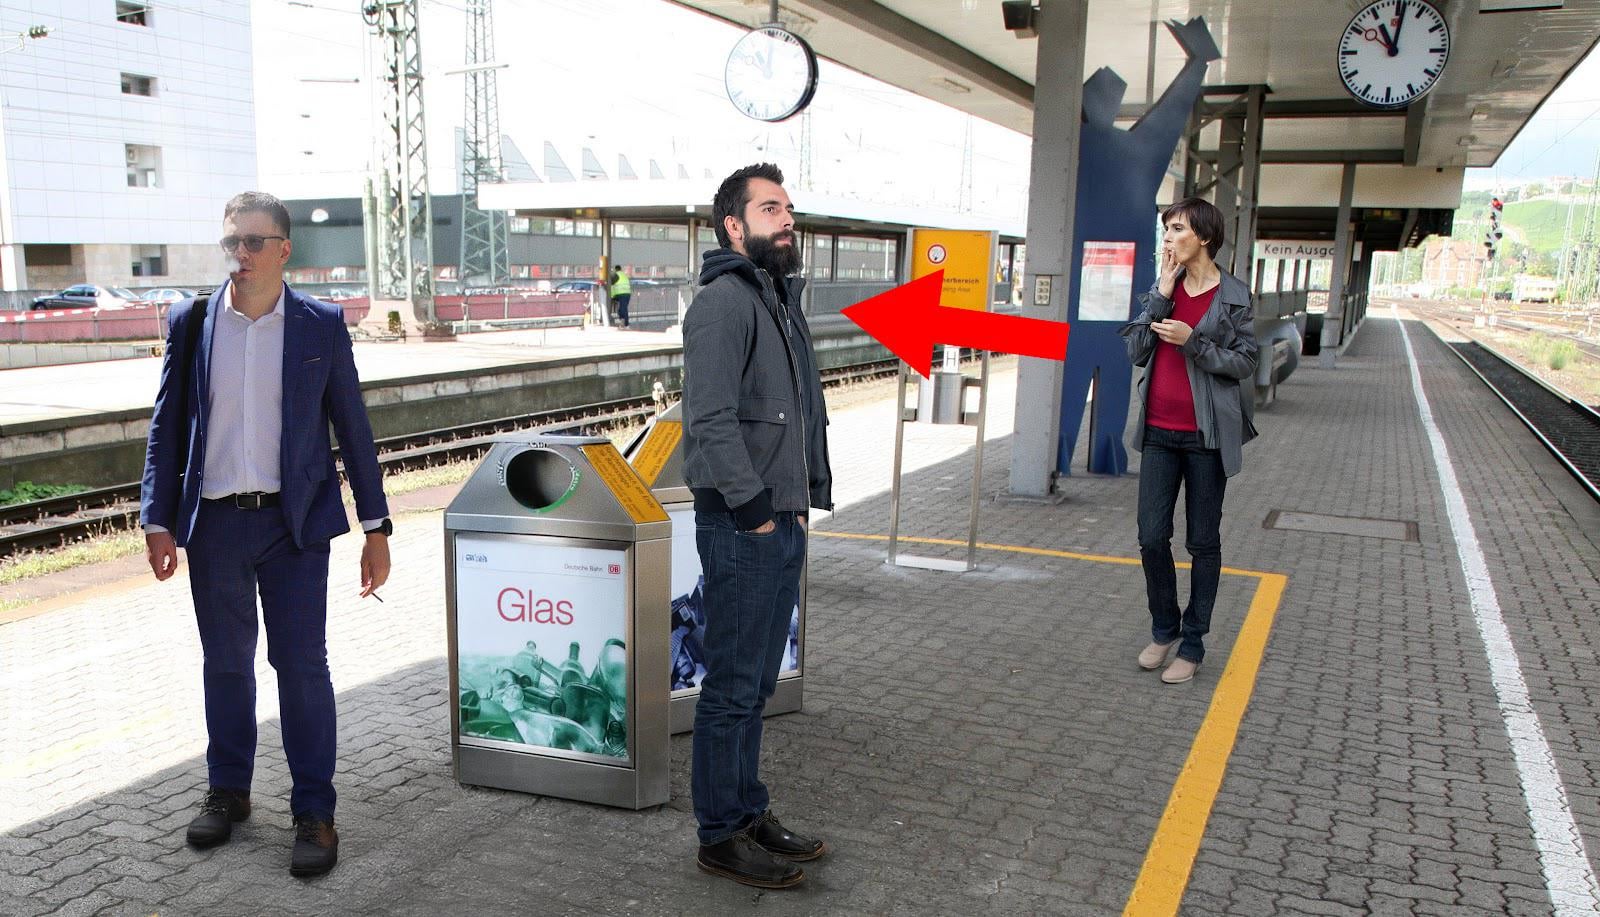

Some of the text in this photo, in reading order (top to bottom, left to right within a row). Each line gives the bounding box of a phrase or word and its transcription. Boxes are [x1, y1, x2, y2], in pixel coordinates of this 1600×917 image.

[1264, 243, 1335, 257] Kein Ausga
[944, 277, 980, 285] erbereich
[946, 351, 956, 367] H
[564, 563, 588, 571] Deutsche
[609, 564, 620, 574] DB
[497, 587, 574, 625] Glas
